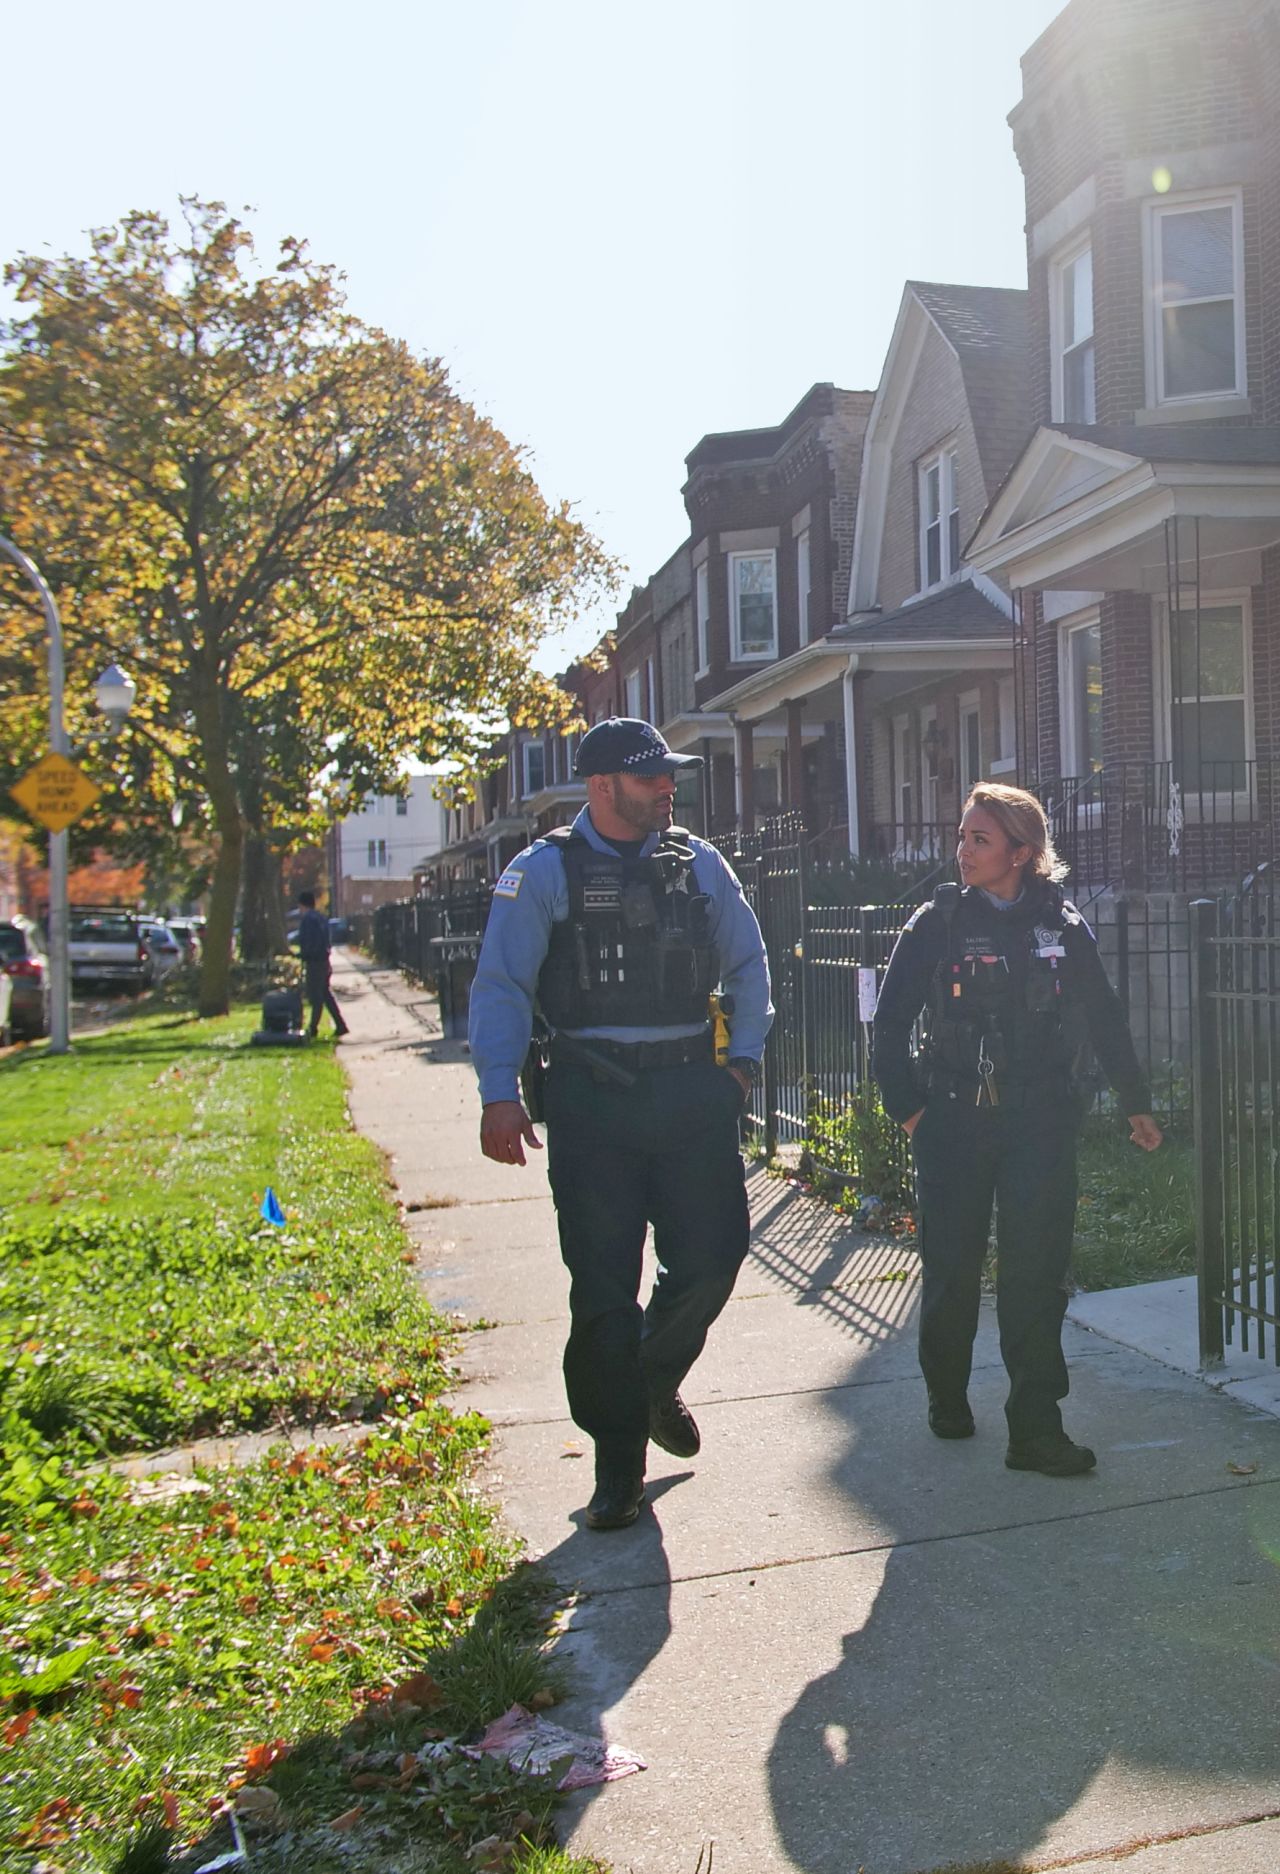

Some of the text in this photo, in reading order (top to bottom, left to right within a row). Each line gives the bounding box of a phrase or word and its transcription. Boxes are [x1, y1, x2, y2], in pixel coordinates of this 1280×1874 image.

[37, 770, 78, 783] SPEED
[37, 786, 75, 797] HUMP
[37, 801, 80, 814] AHEAD
